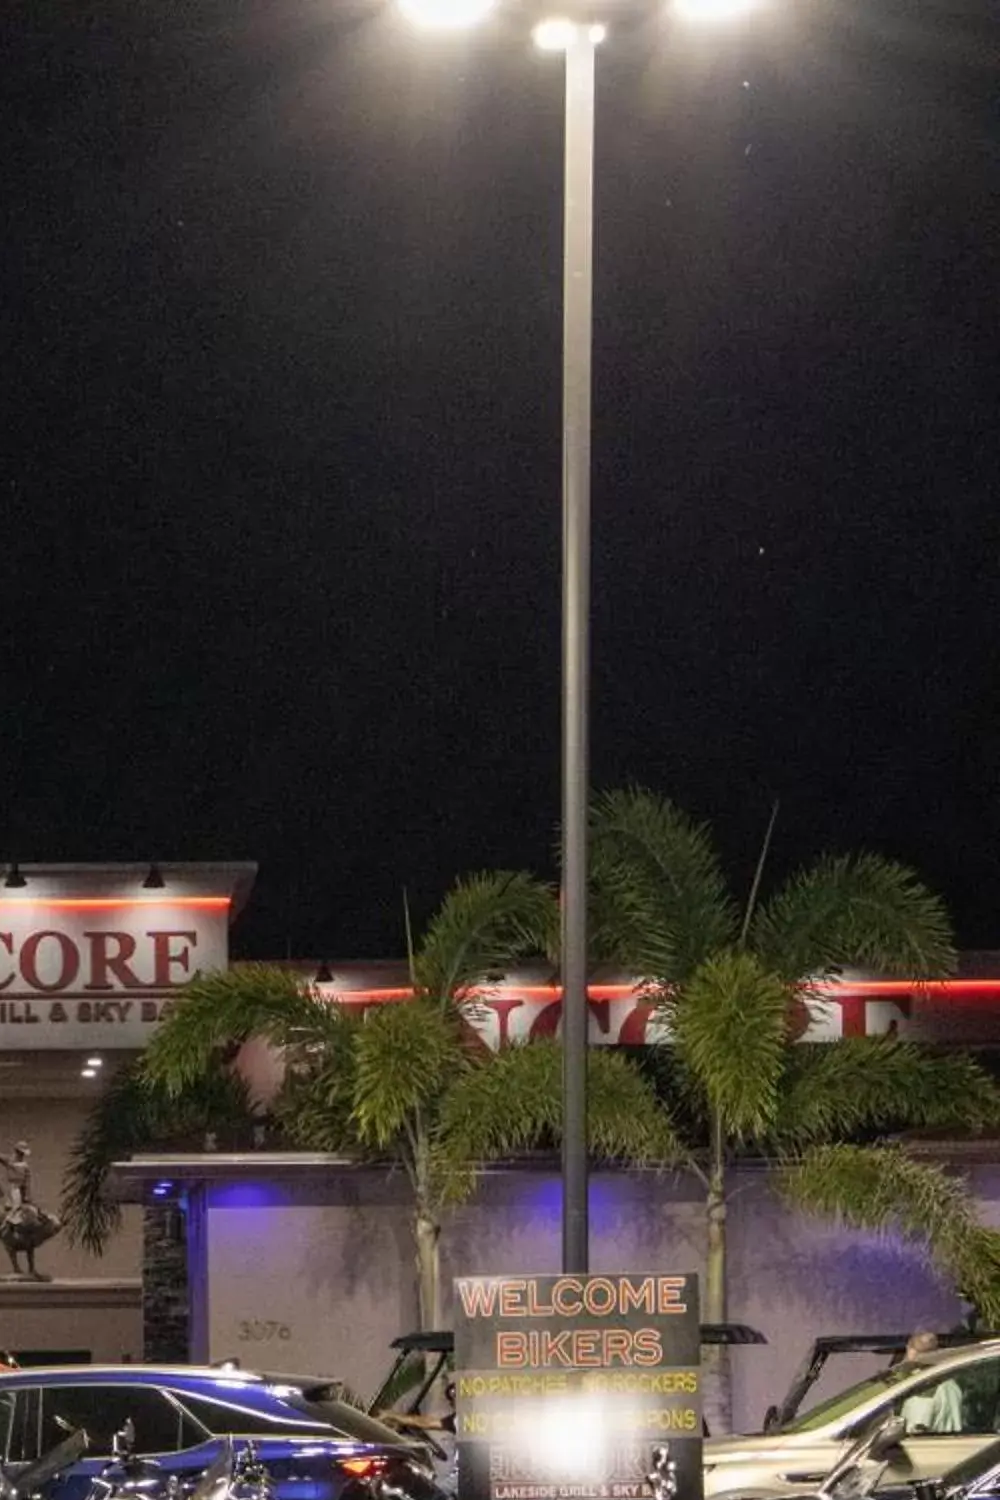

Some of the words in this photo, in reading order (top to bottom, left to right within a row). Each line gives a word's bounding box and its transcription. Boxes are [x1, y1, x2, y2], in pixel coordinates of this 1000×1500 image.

[49, 1002, 69, 1024] &
[77, 1001, 134, 1024] SKY
[140, 1001, 175, 1023] BA
[457, 1276, 687, 1318] WELCOME
[496, 1327, 664, 1369] BIKERS
[459, 1376, 485, 1397] NO
[495, 1484, 556, 1499] LAKESIDE
[613, 1484, 639, 1497] SKY
